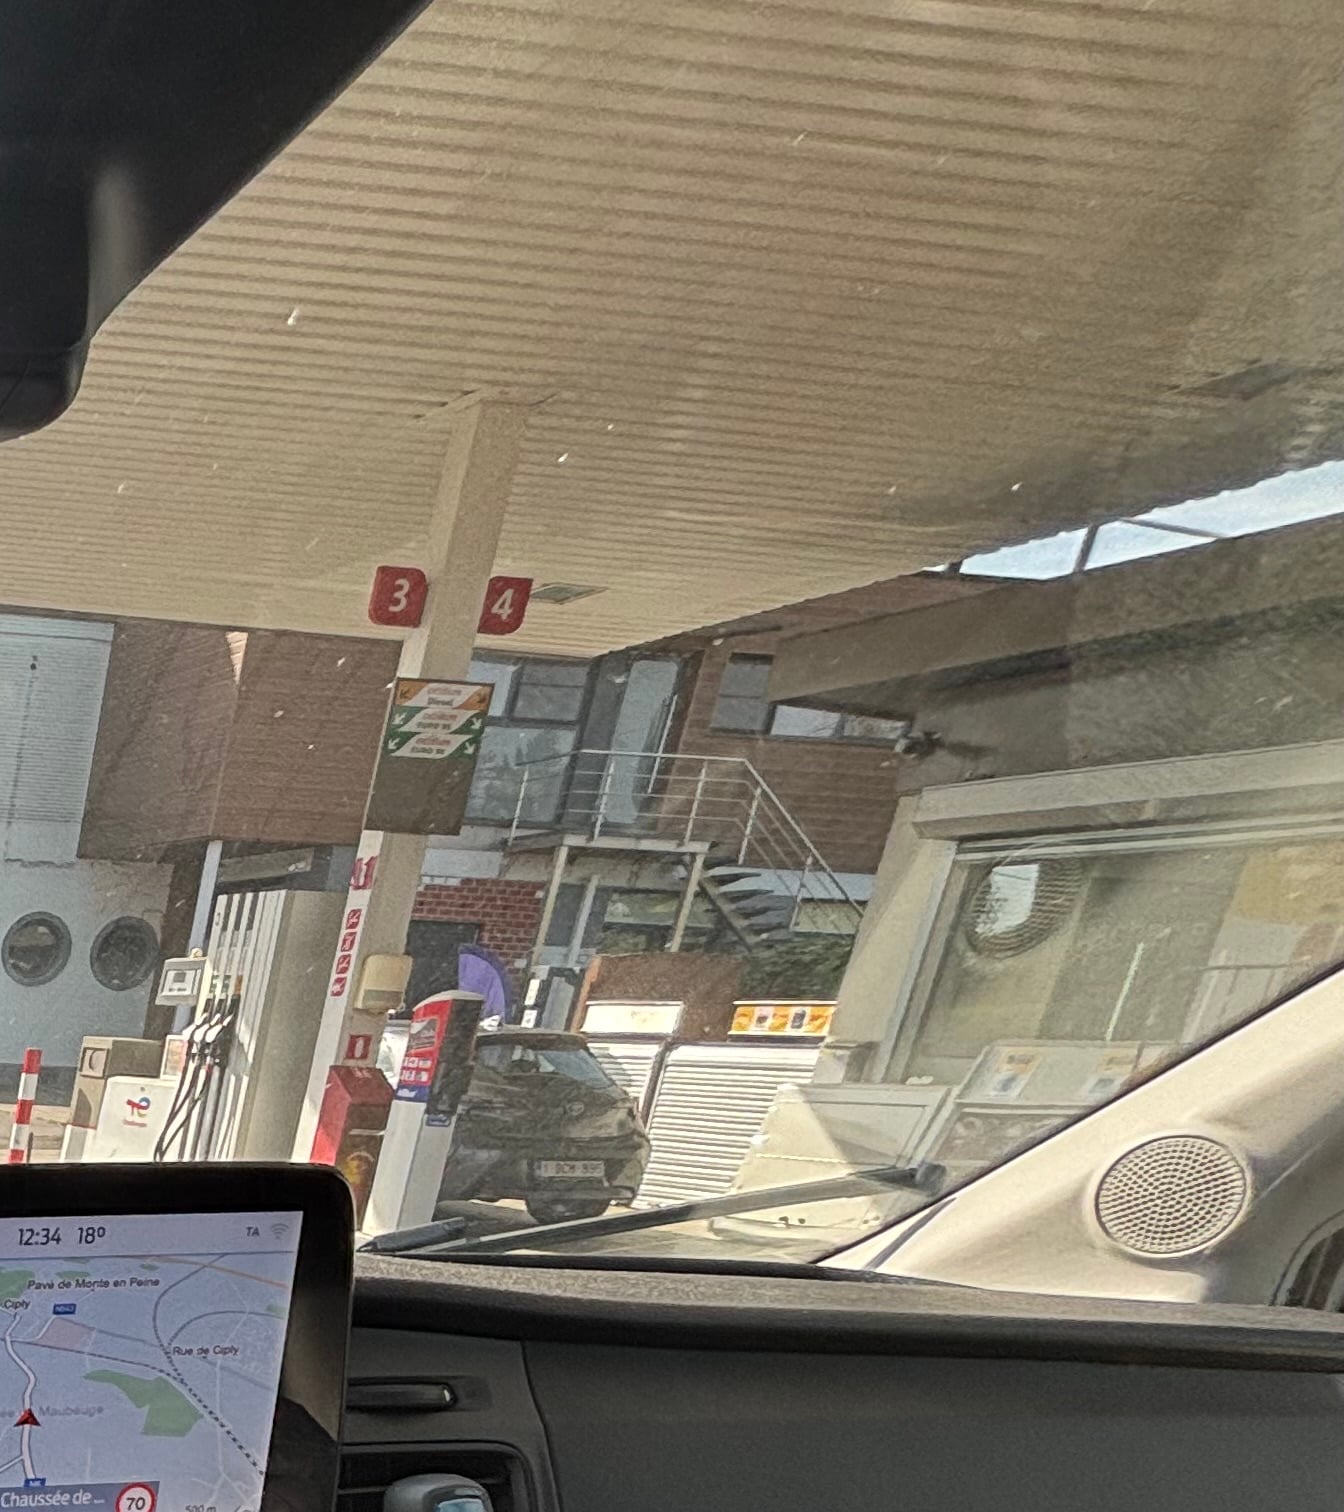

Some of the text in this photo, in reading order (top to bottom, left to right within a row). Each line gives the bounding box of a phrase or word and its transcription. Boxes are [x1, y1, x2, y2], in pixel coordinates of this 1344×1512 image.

[388, 578, 410, 612] 3
[491, 588, 514, 621] 4
[18, 1226, 62, 1246] 12:34
[246, 1226, 260, 1237] TA
[58, 1279, 72, 1289] de
[113, 1279, 126, 1288] en
[173, 1346, 193, 1356] Rue
[197, 1346, 210, 1355] de
[0, 1492, 69, 1508] Chaussée
[72, 1492, 92, 1505] de
[126, 1497, 146, 1511] 70
